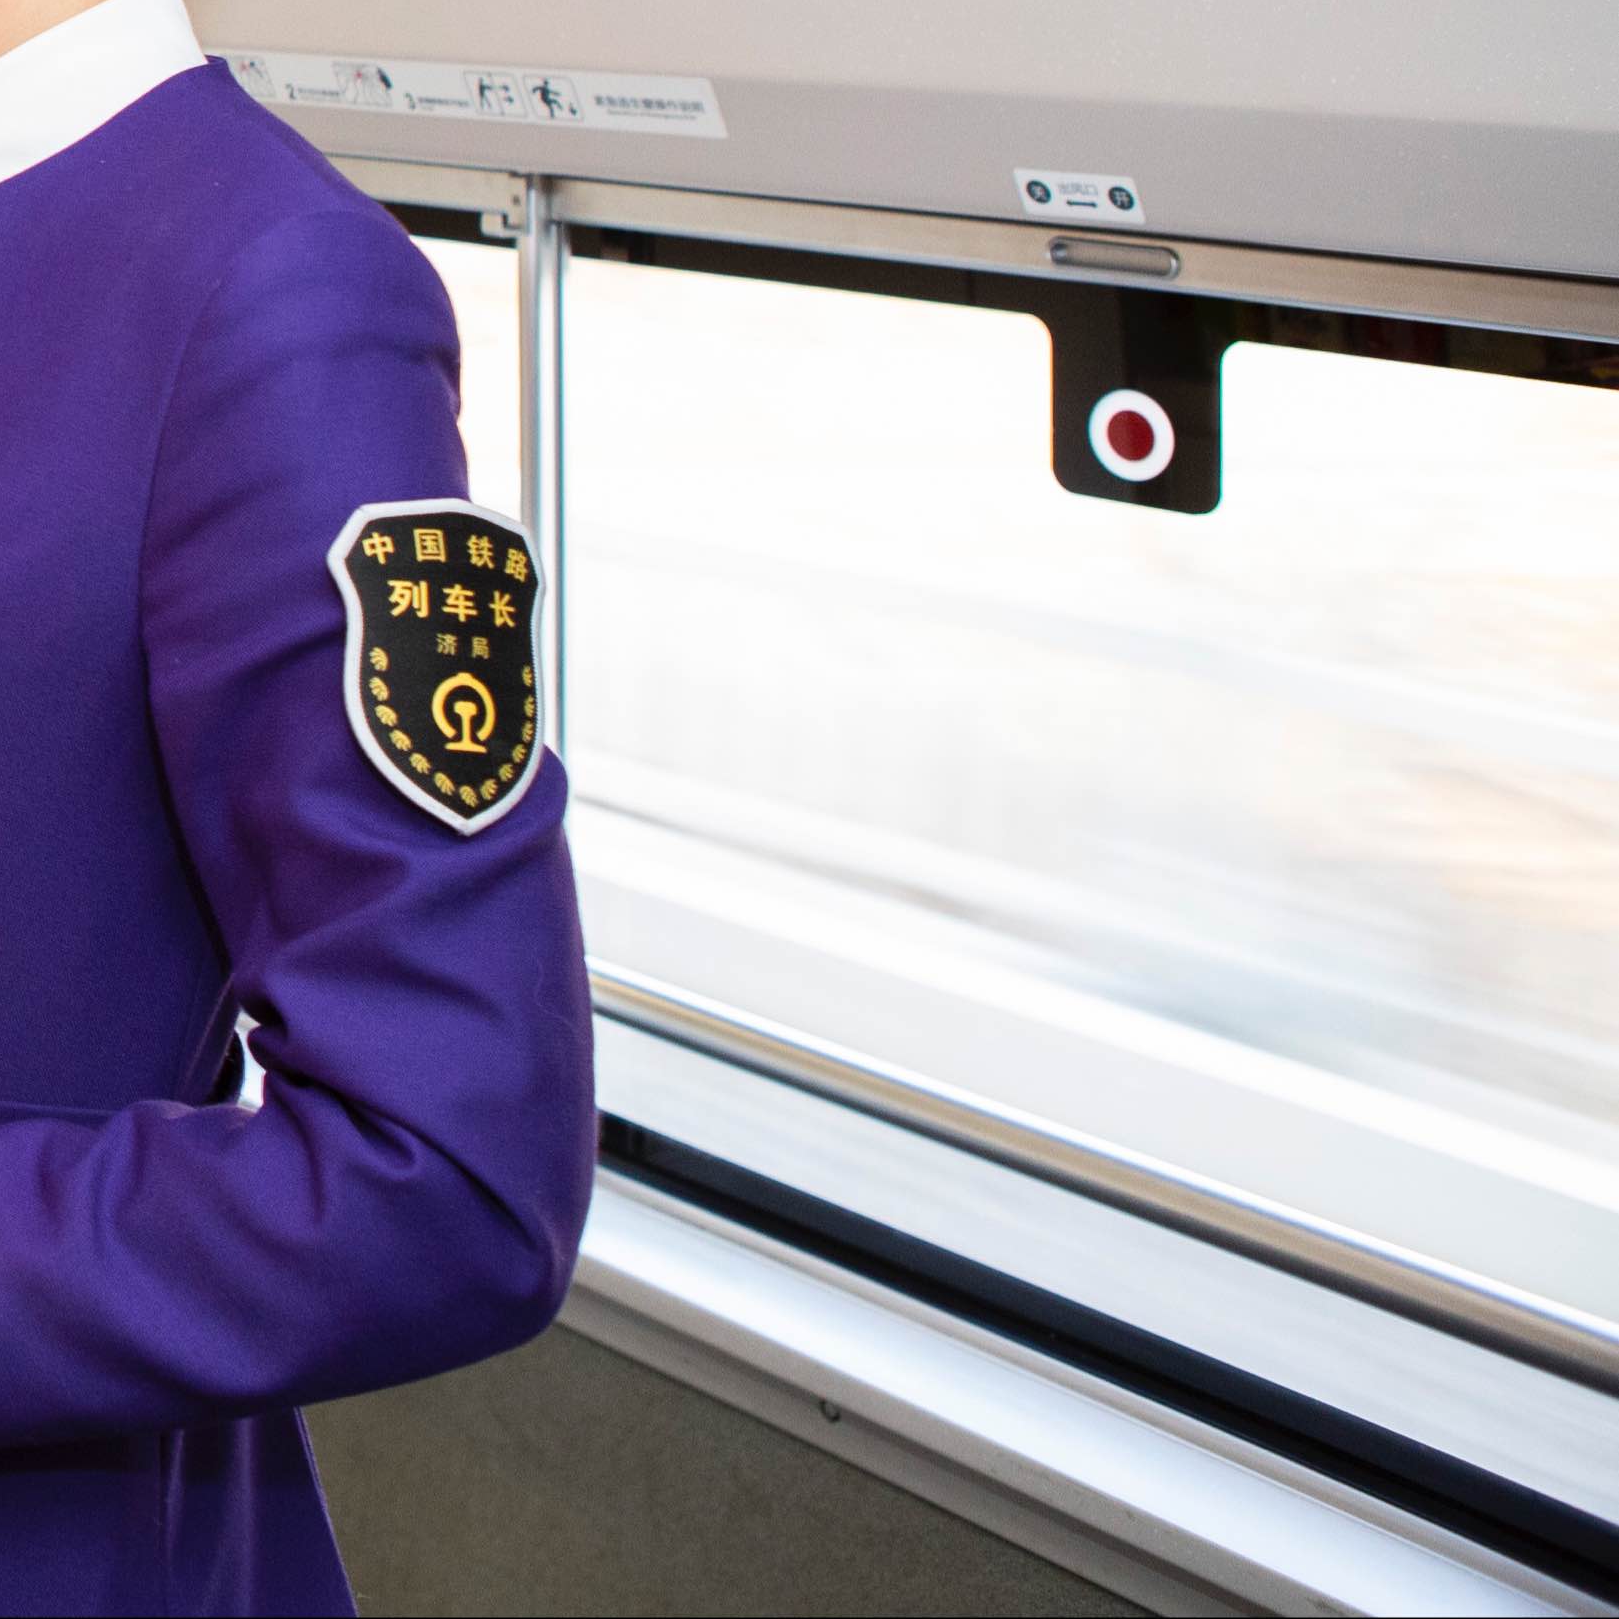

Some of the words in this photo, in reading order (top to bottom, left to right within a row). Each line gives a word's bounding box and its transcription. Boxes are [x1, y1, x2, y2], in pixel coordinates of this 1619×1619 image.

[362, 528, 529, 583] 中国铁路
[387, 580, 516, 628] 列车长
[436, 633, 491, 660] 济局
